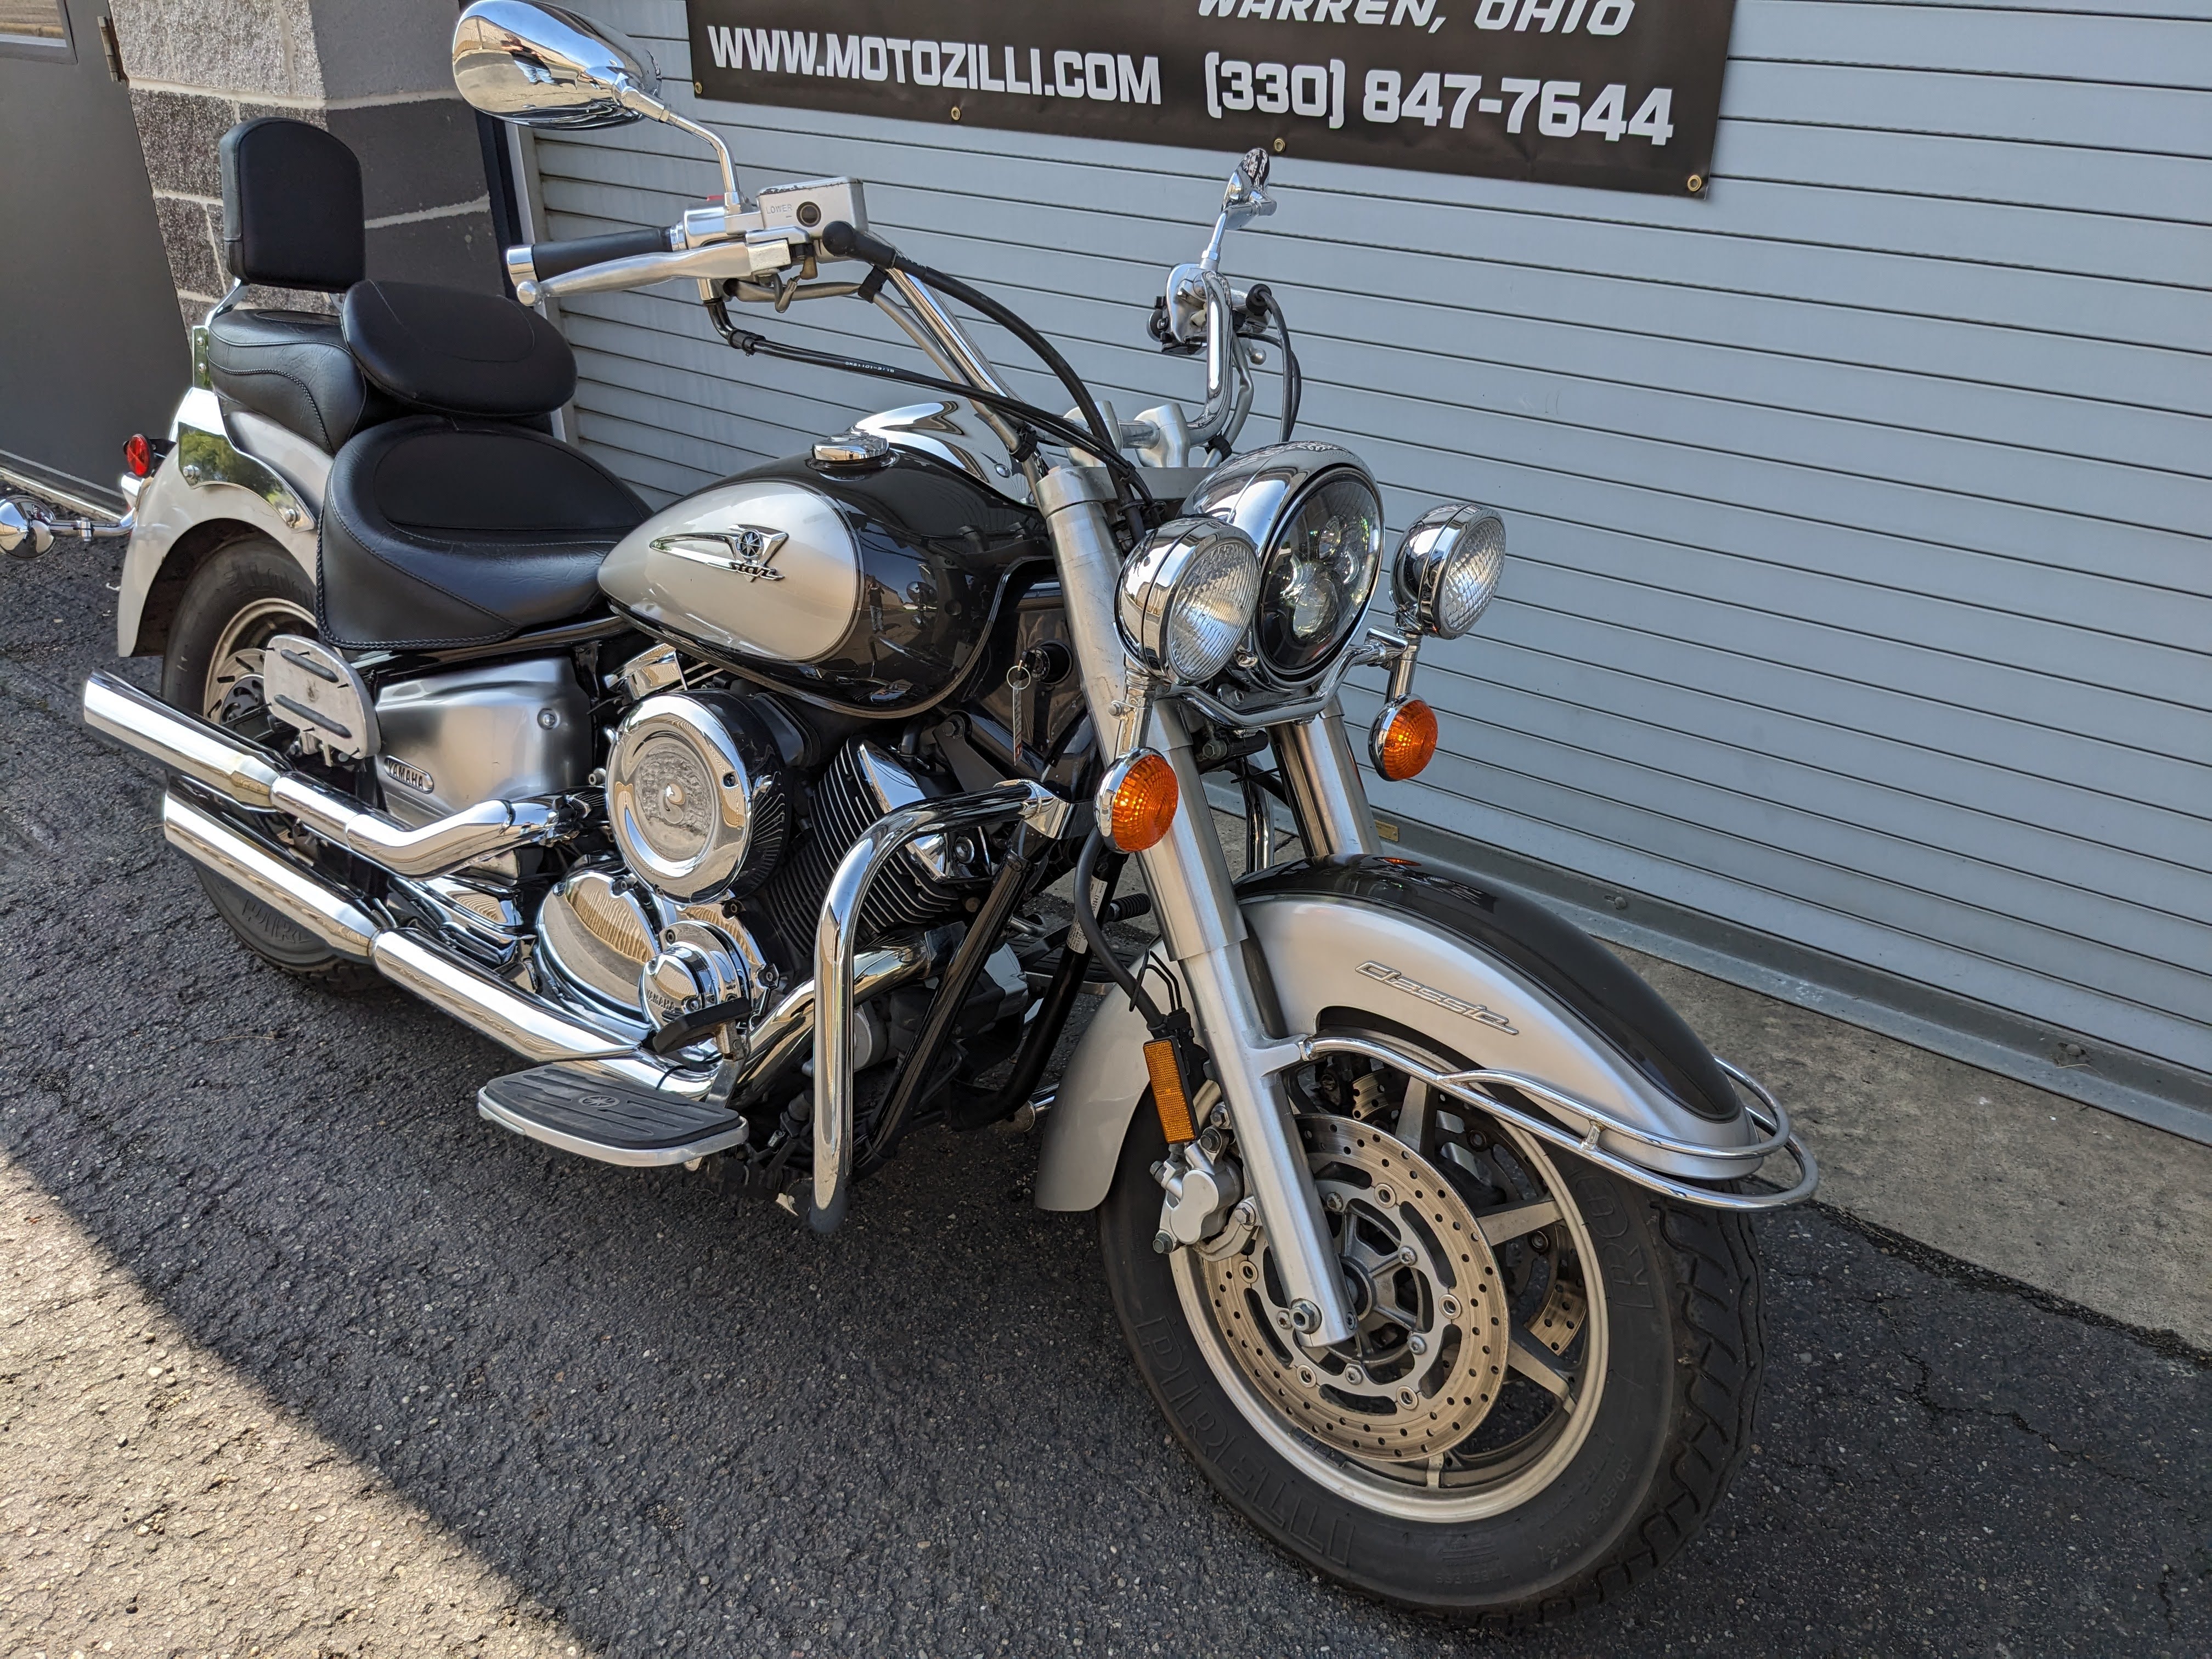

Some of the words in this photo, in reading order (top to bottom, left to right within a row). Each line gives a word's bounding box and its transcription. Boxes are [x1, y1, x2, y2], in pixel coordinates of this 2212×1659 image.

[1474, 0, 1635, 36] OHIO
[707, 25, 1161, 105] WWW.MOTOZILLI.COM
[1205, 52, 1345, 129] (330)
[1363, 69, 1674, 146] 847-7644
[766, 204, 792, 214] LOWER
[387, 759, 424, 790] YAMAHA
[646, 988, 676, 1012] YAMAHA
[1133, 1314, 1356, 1567] PIRELLI
